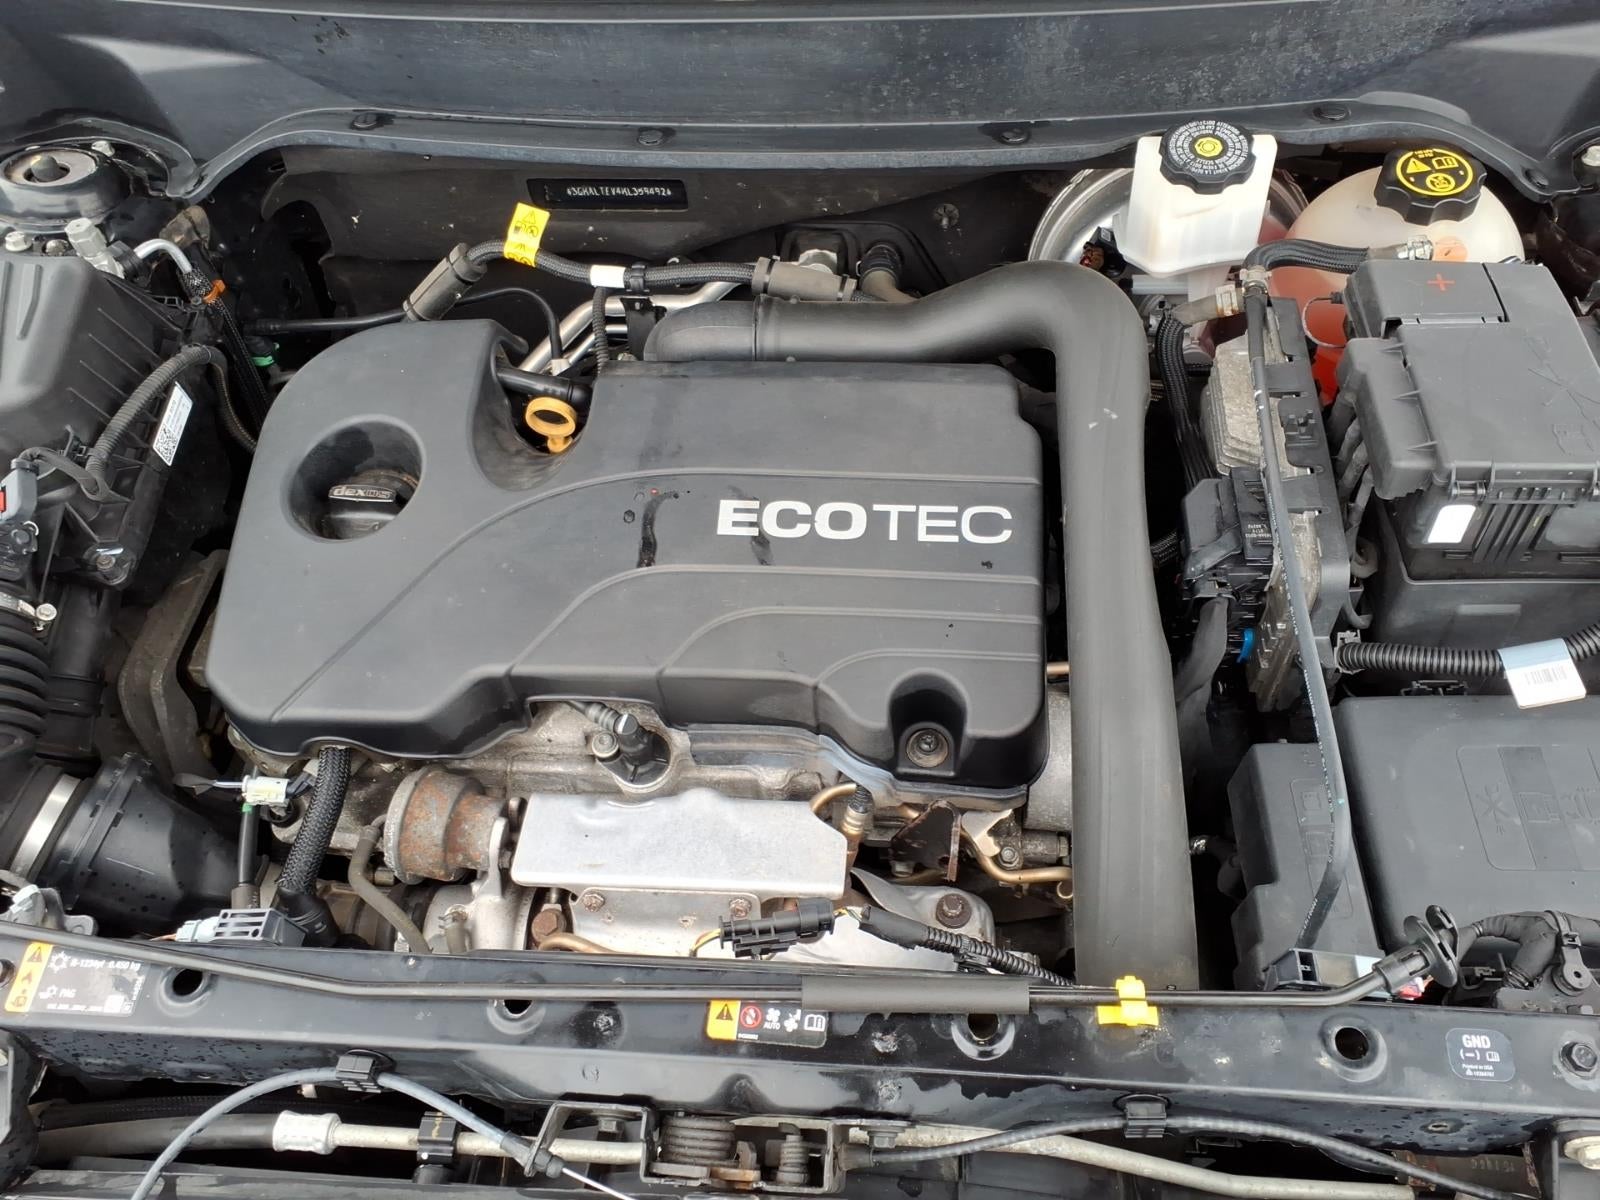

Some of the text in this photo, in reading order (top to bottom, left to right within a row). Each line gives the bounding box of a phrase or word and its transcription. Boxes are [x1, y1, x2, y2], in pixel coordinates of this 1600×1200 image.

[716, 499, 1013, 544] ECOTEC
[59, 988, 77, 998] PAG
[763, 1022, 781, 1030] AUTO
[1462, 1034, 1491, 1049] GND
